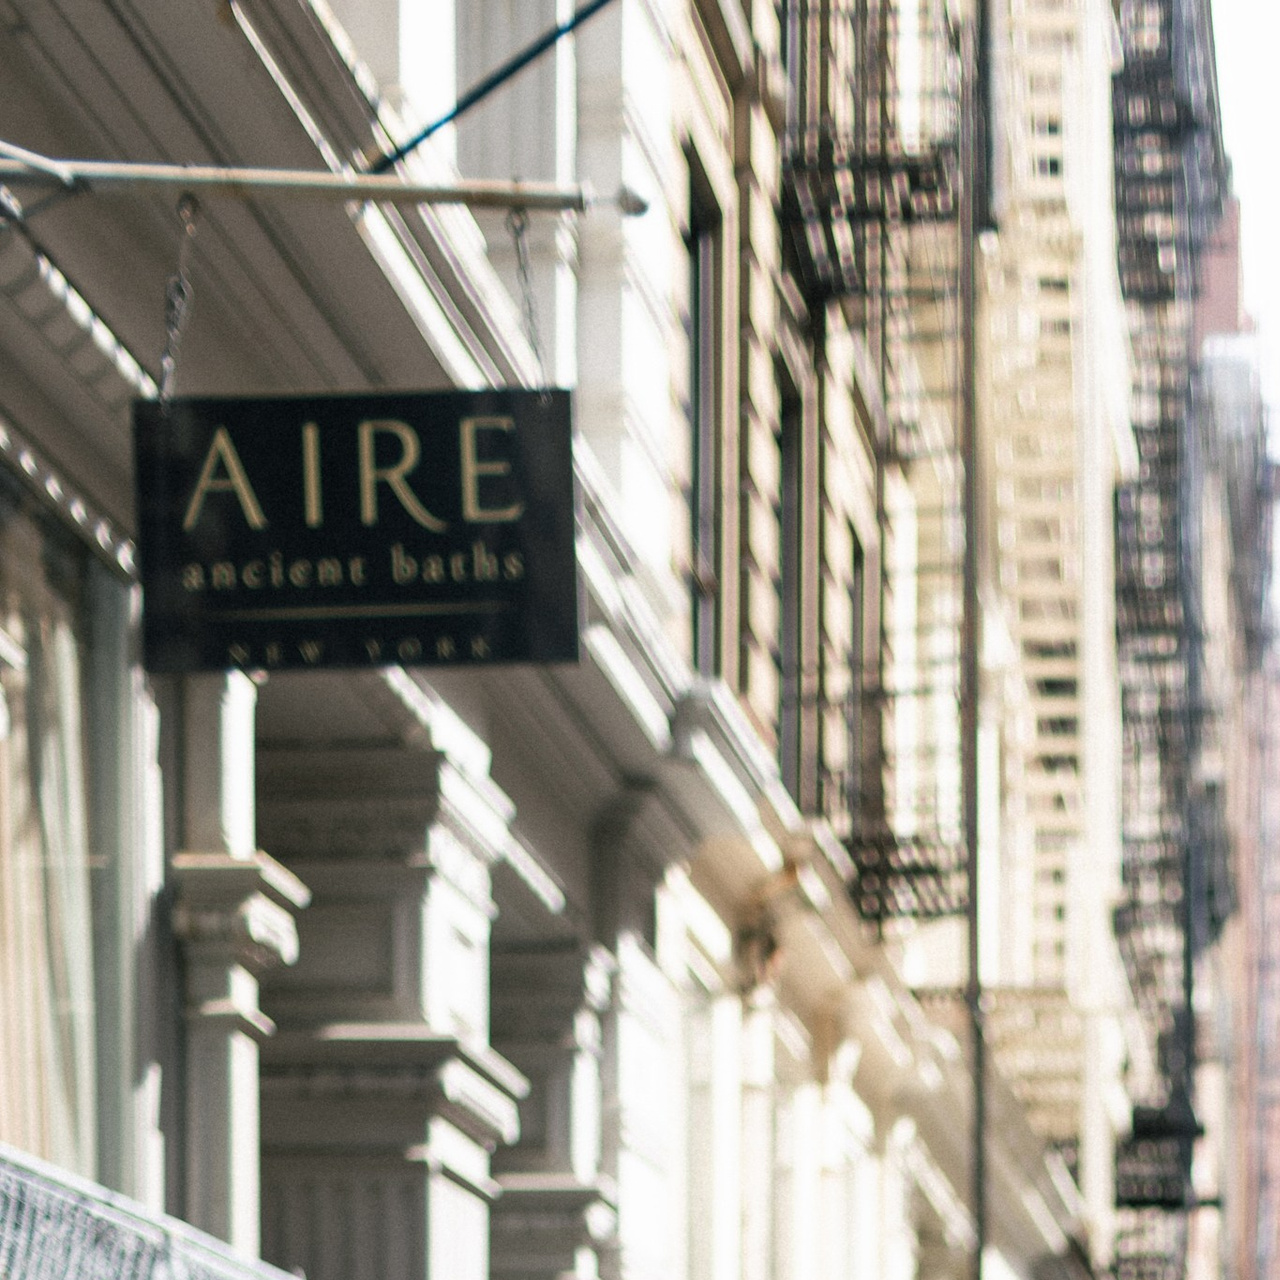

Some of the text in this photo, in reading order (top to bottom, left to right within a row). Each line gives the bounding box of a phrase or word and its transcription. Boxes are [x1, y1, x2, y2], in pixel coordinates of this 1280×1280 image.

[181, 415, 526, 532] AIRE
[183, 541, 526, 593] ancient baths
